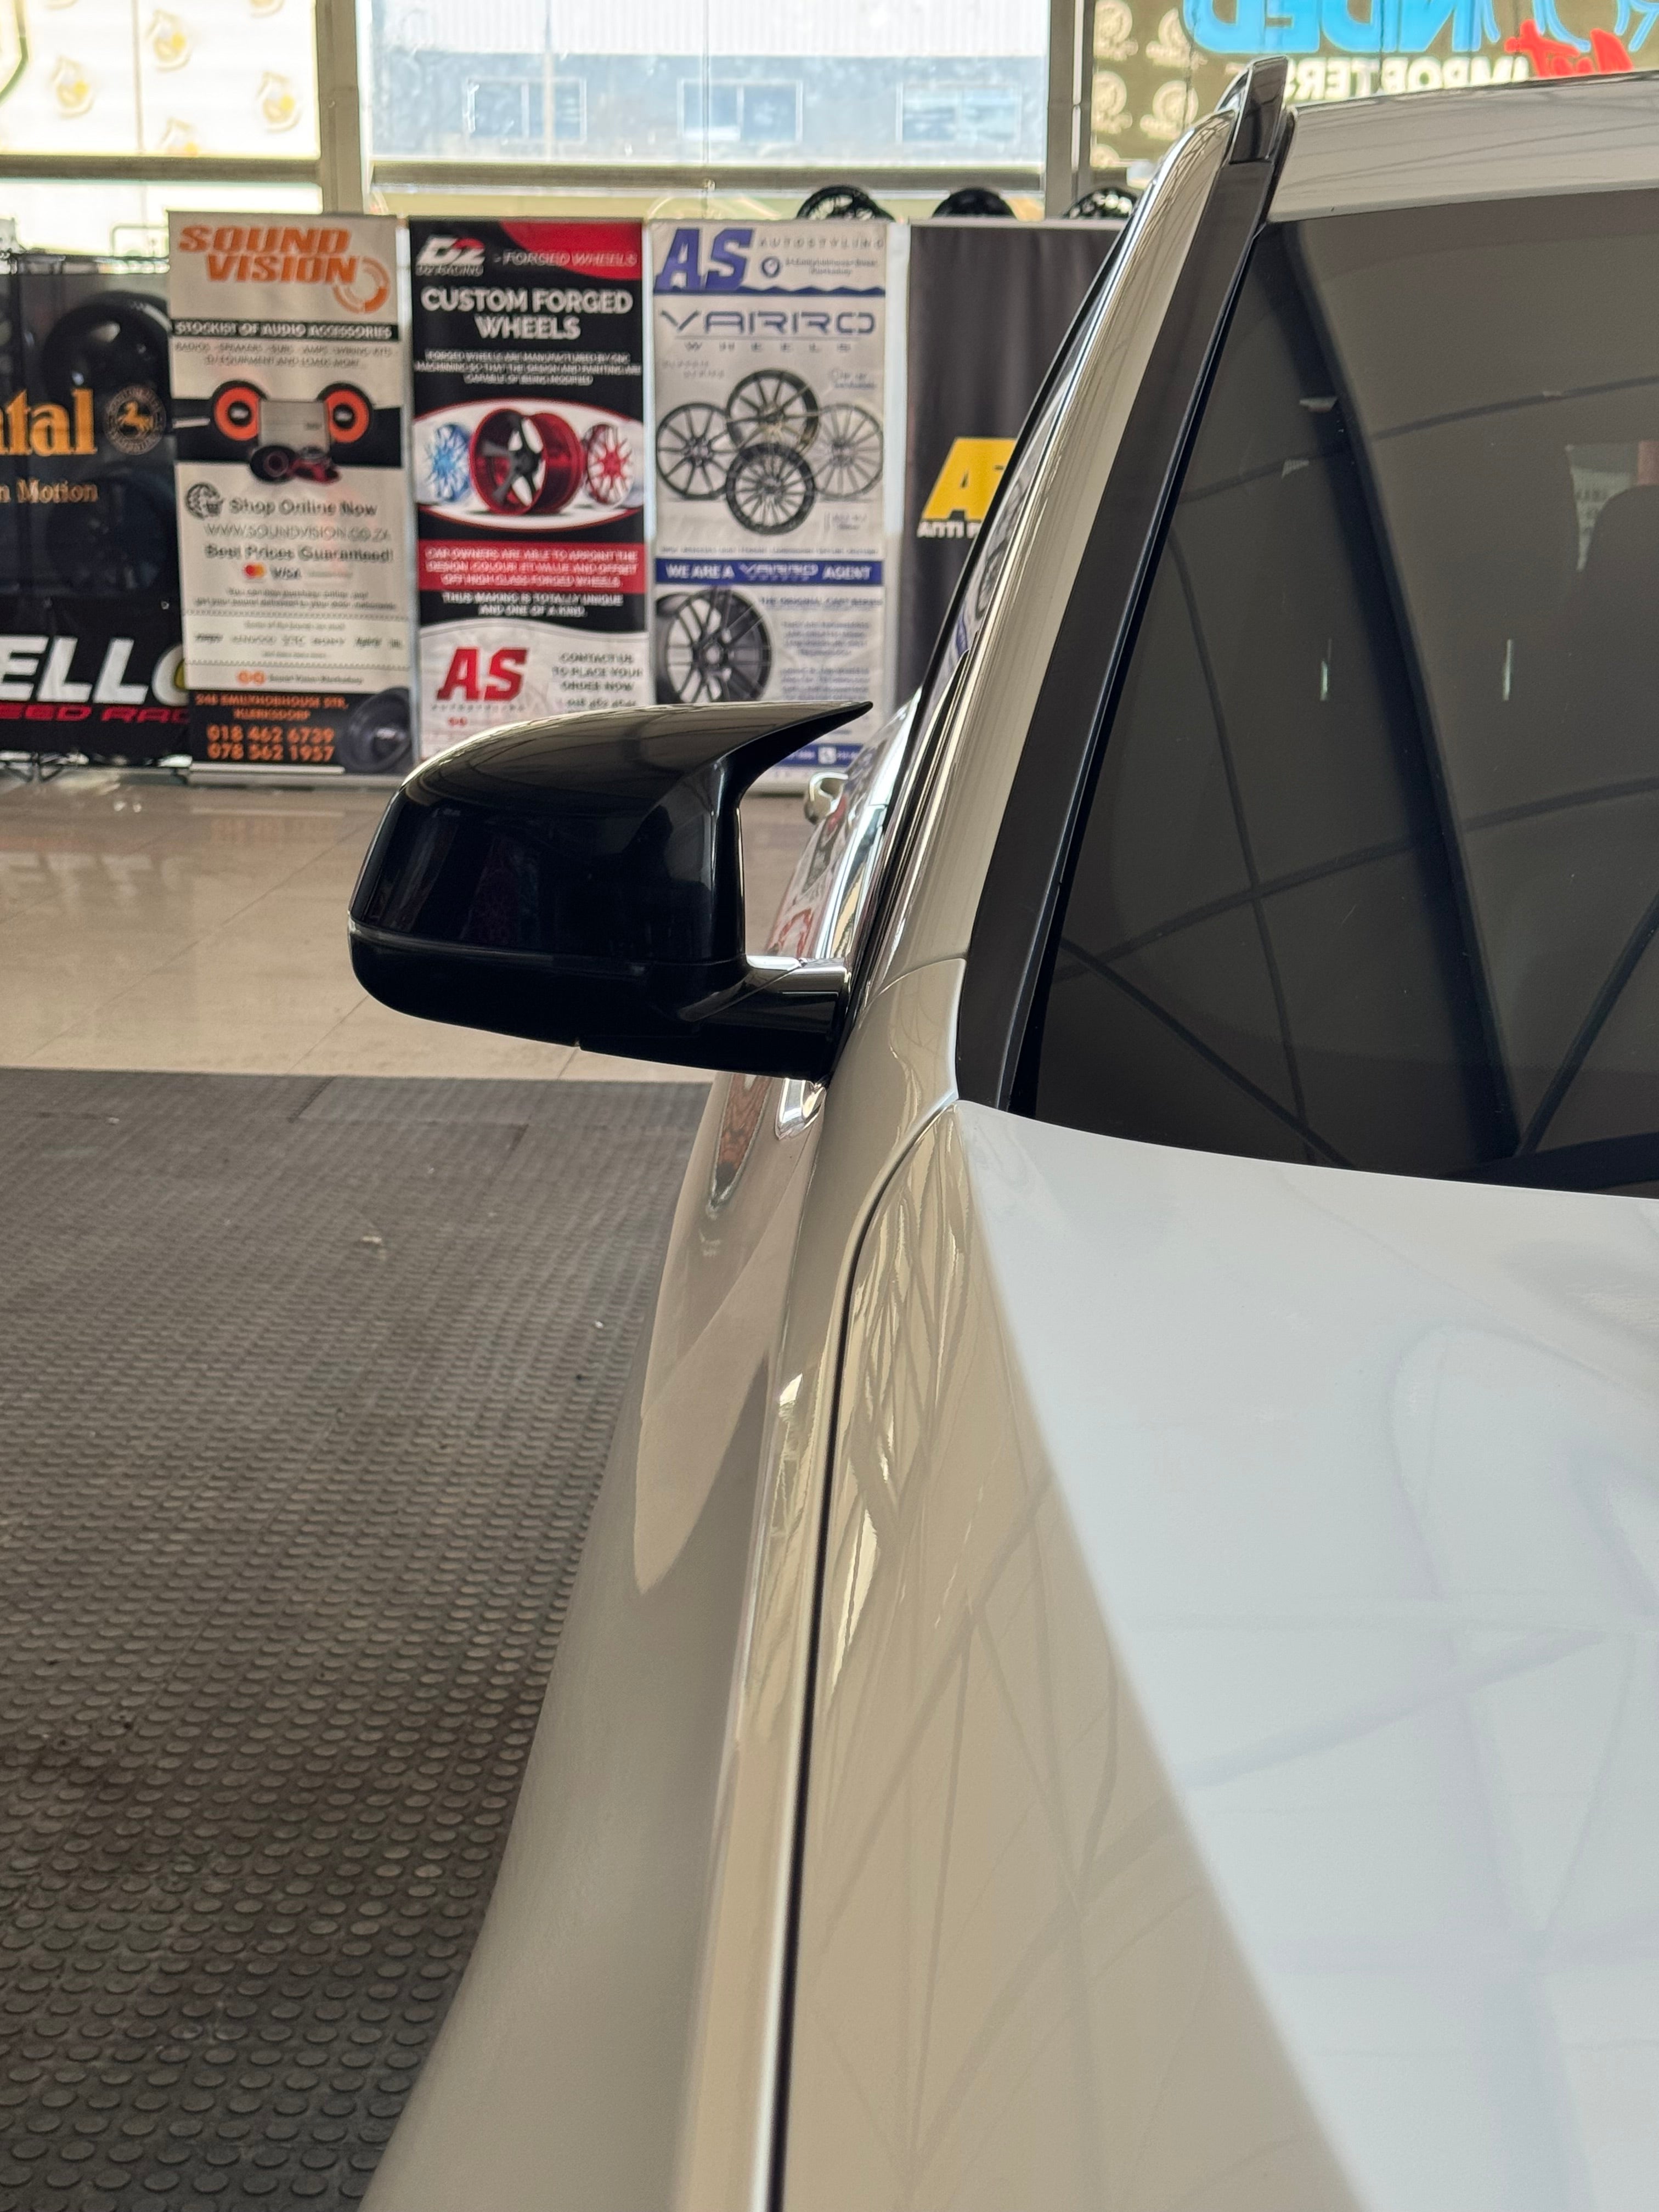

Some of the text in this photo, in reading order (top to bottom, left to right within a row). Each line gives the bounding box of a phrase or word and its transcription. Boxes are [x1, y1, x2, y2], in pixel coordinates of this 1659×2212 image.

[179, 225, 351, 253] SOUND
[206, 255, 360, 284] VISION
[503, 250, 637, 267] FORGED WHEELS
[654, 228, 753, 290] AS
[420, 285, 634, 314] CUSTOM FORGED
[174, 321, 393, 339] STOCKIST OF AUDIO ACCESSORIES
[474, 315, 582, 340] WHEELS
[661, 310, 876, 334] VARRO
[0, 388, 97, 456] tal
[16, 478, 98, 503] Motion
[229, 498, 377, 517] Shop Online Now
[245, 544, 295, 560] Prices
[665, 564, 691, 579] WE
[691, 565, 720, 579] ARE
[721, 565, 736, 579] A
[822, 565, 873, 580] AGENT
[437, 646, 529, 702] AS
[207, 724, 244, 742] 018
